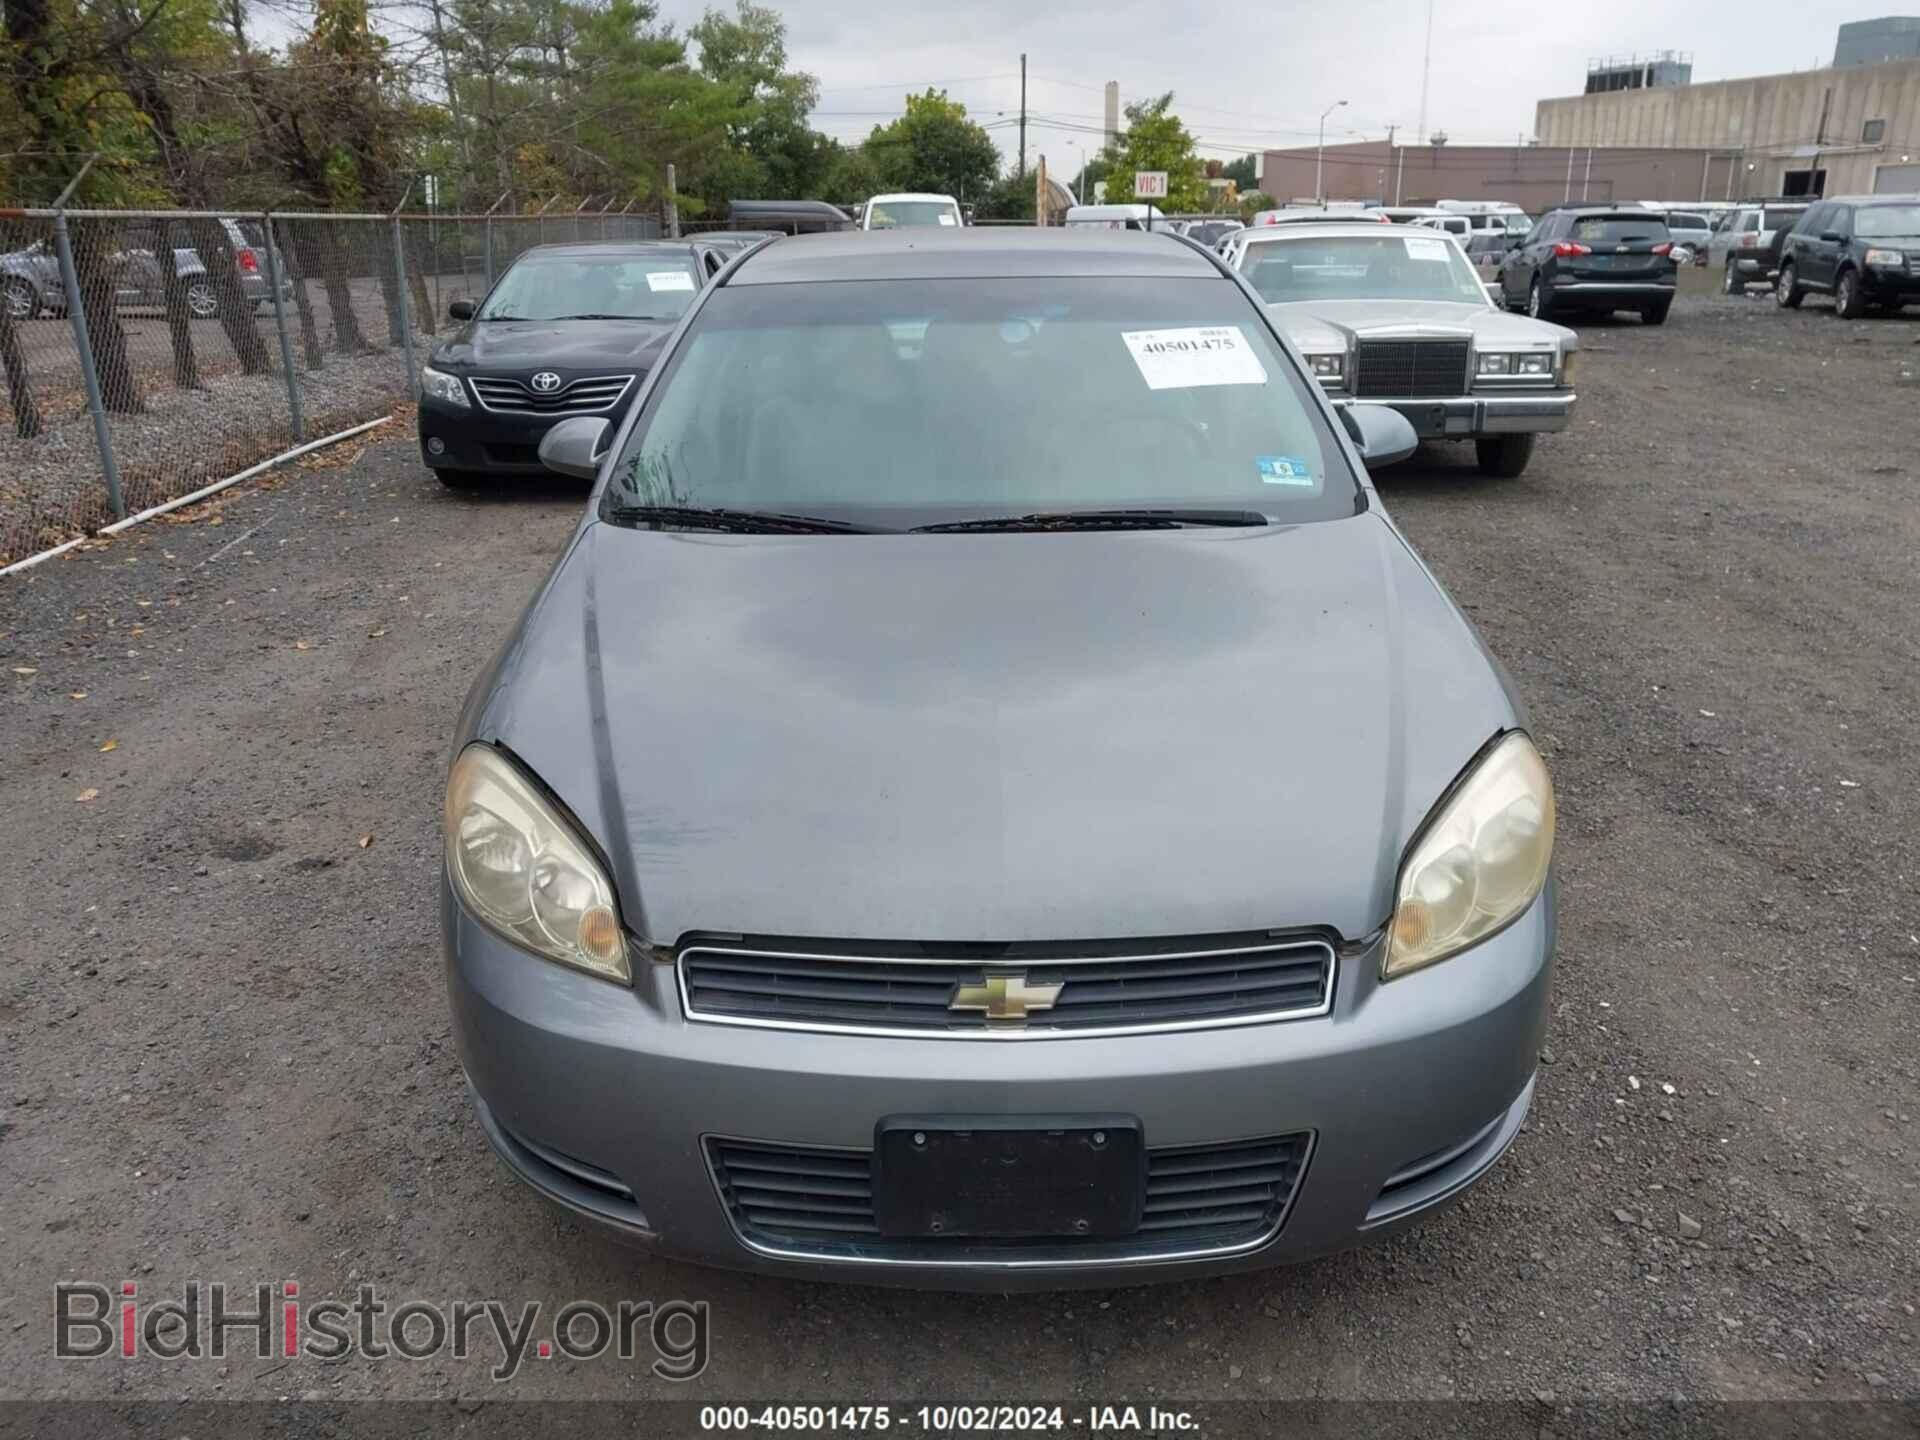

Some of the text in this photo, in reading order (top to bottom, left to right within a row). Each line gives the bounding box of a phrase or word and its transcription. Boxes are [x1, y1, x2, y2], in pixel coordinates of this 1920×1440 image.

[1138, 175, 1165, 193] VIC 1
[1142, 337, 1236, 353] 40501475
